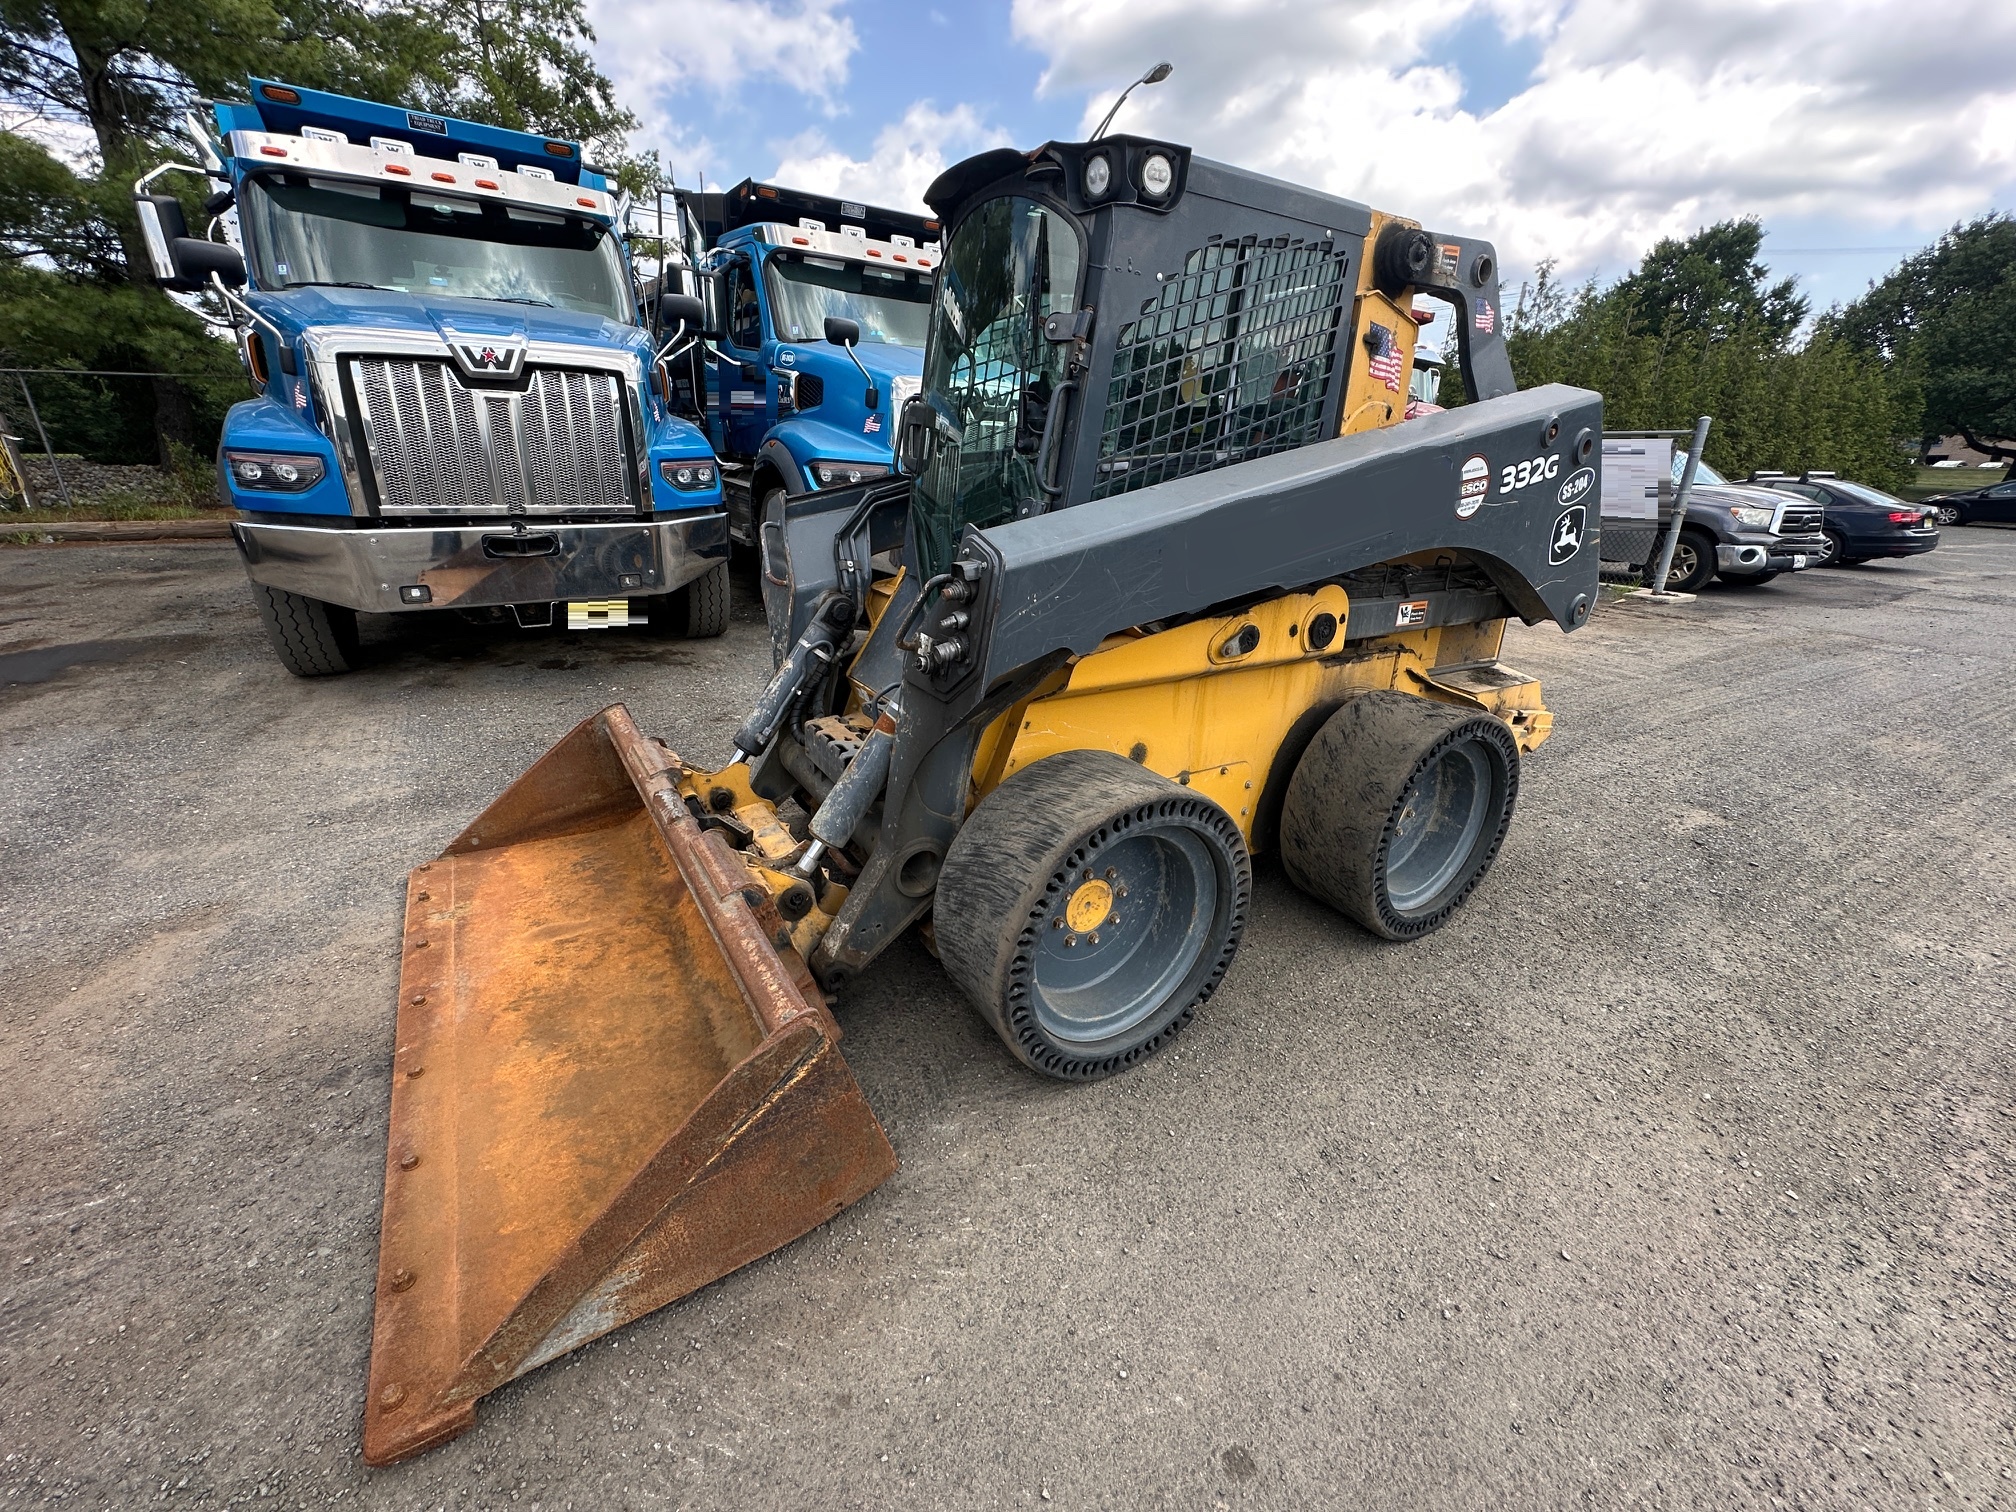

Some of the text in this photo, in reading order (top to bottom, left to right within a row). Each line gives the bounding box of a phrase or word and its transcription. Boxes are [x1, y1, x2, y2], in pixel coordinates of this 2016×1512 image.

[1499, 453, 1560, 494] 332G
[1562, 473, 1589, 500] SS-204
[1461, 479, 1488, 496] ESCO
